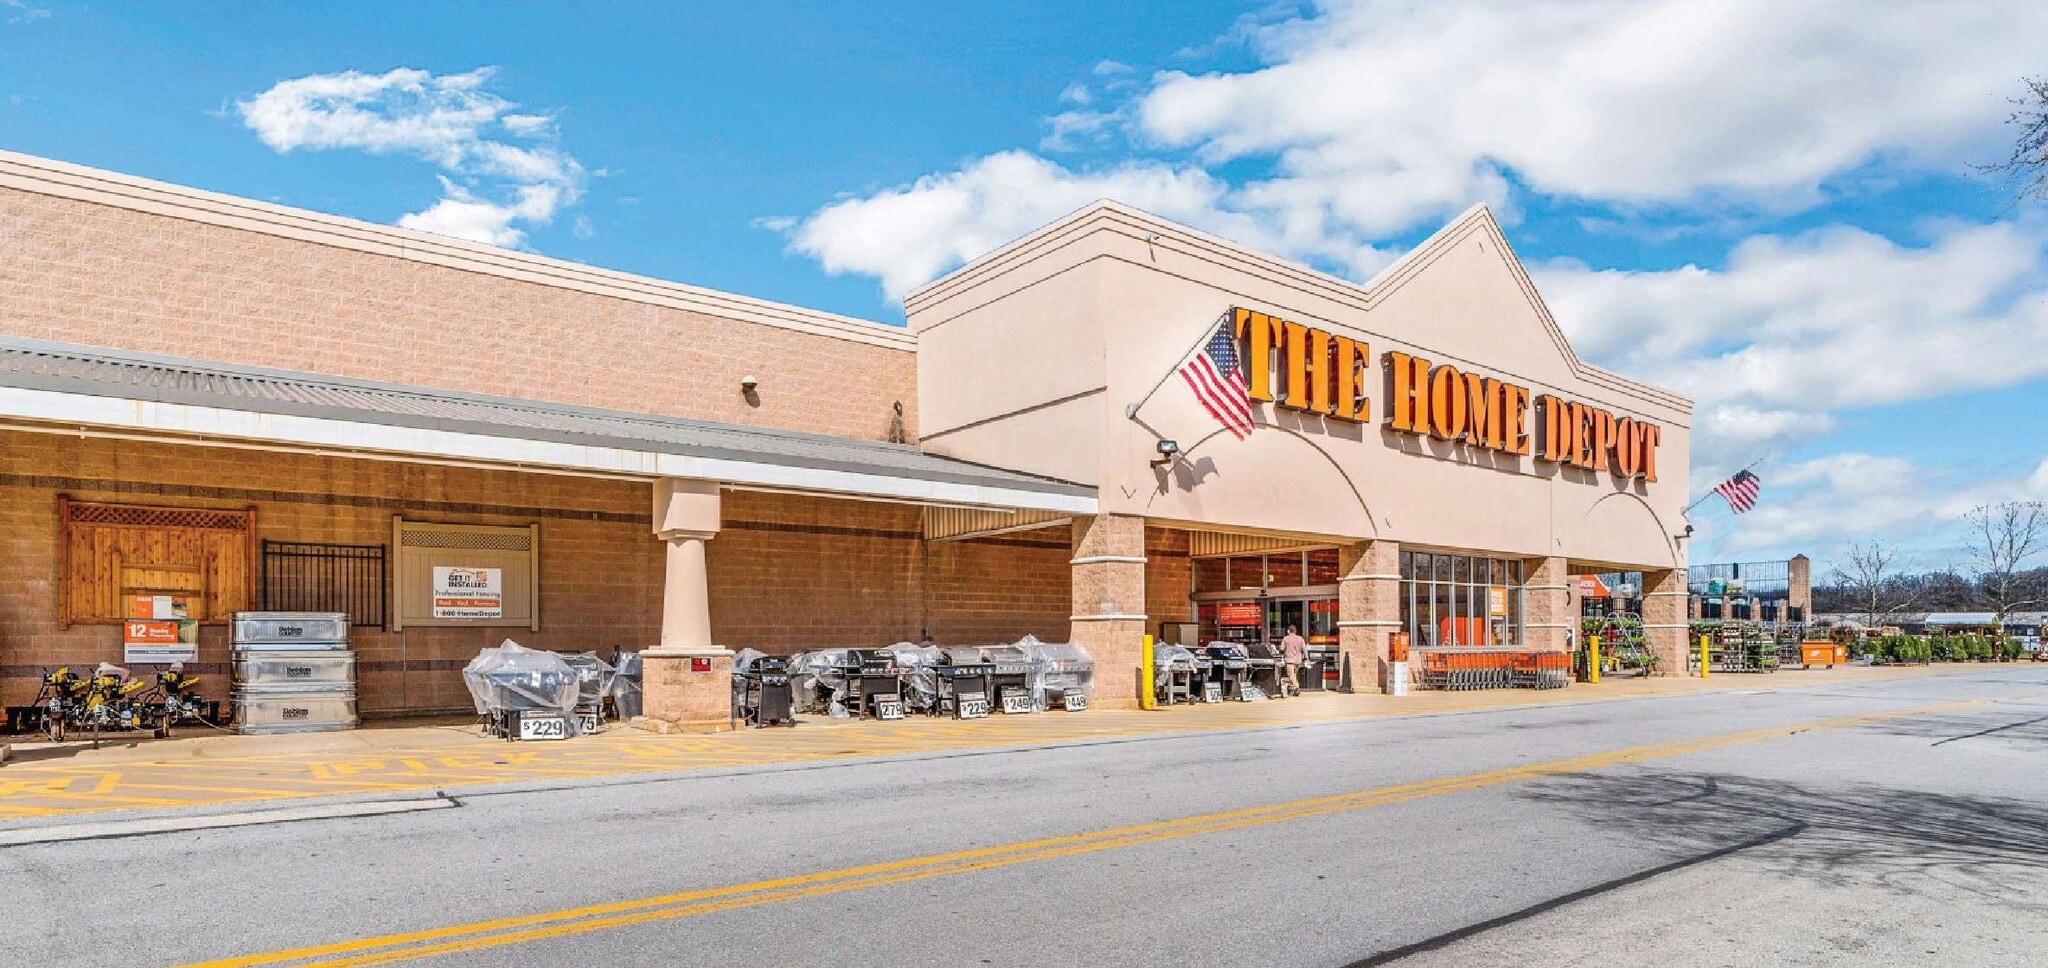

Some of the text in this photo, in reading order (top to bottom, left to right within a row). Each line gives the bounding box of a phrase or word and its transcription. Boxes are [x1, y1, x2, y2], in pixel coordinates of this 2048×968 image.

[1236, 307, 1661, 483] THE HOME DEPOT
[129, 624, 146, 638] 12
[882, 704, 903, 716] 279
